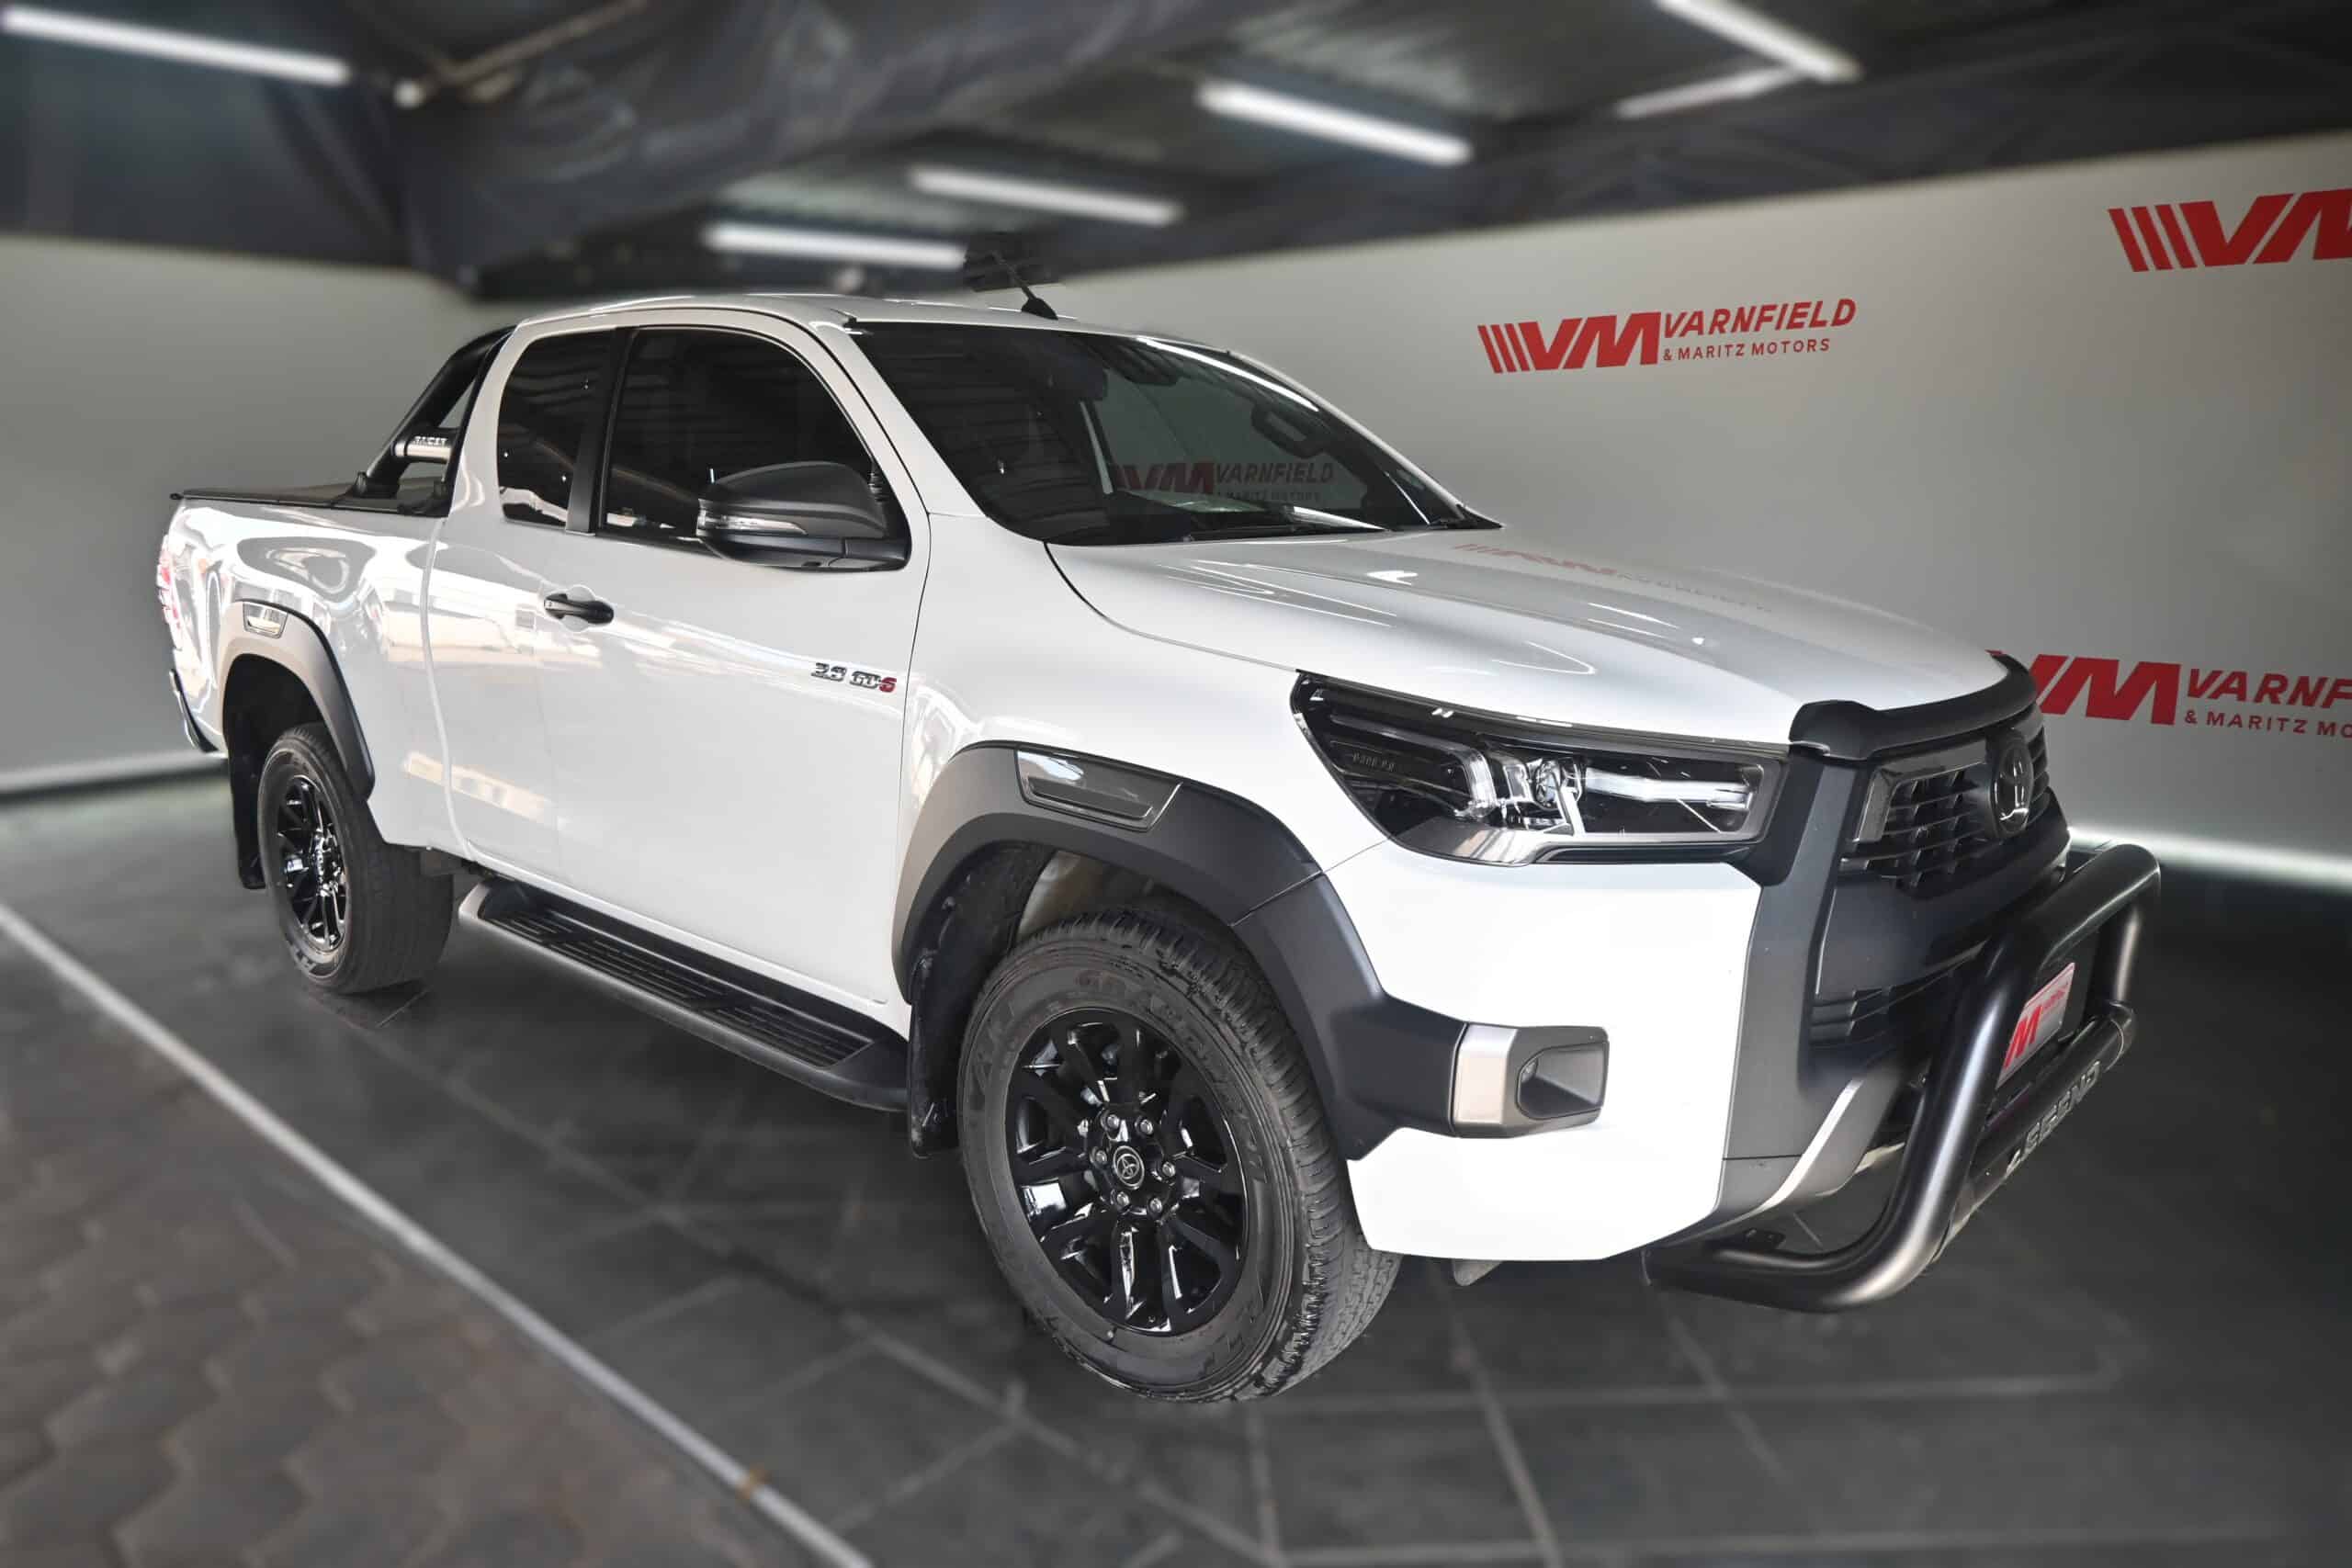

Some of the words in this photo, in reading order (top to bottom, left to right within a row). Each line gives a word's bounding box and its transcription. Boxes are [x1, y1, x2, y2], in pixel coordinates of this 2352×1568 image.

[1664, 298, 1857, 339] VARNFIELD
[1518, 311, 1662, 371] VM
[1663, 349, 1673, 361] &
[1677, 344, 1746, 361] MARITZ
[1750, 337, 1830, 356] MOTORS
[1216, 462, 1333, 484] VARNFIELD
[2187, 668, 2352, 709] VARNF
[2185, 709, 2198, 725] &
[2206, 711, 2308, 734] MARITZ
